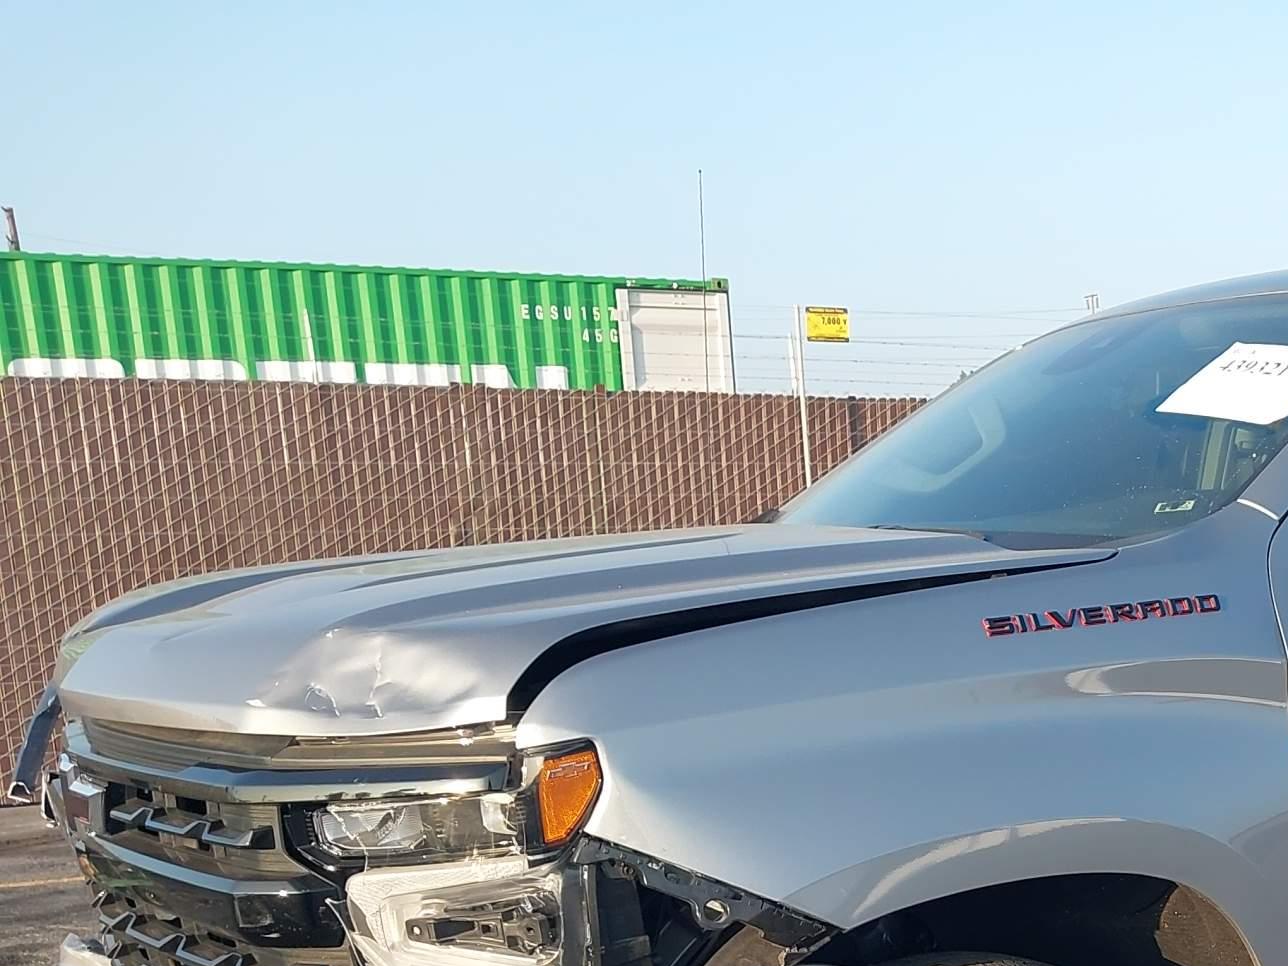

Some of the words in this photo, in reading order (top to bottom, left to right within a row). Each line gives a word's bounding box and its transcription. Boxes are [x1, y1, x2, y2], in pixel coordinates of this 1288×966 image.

[520, 304, 572, 320] EGSU
[582, 328, 619, 343] 45G
[981, 594, 1221, 639] SILVERADO
